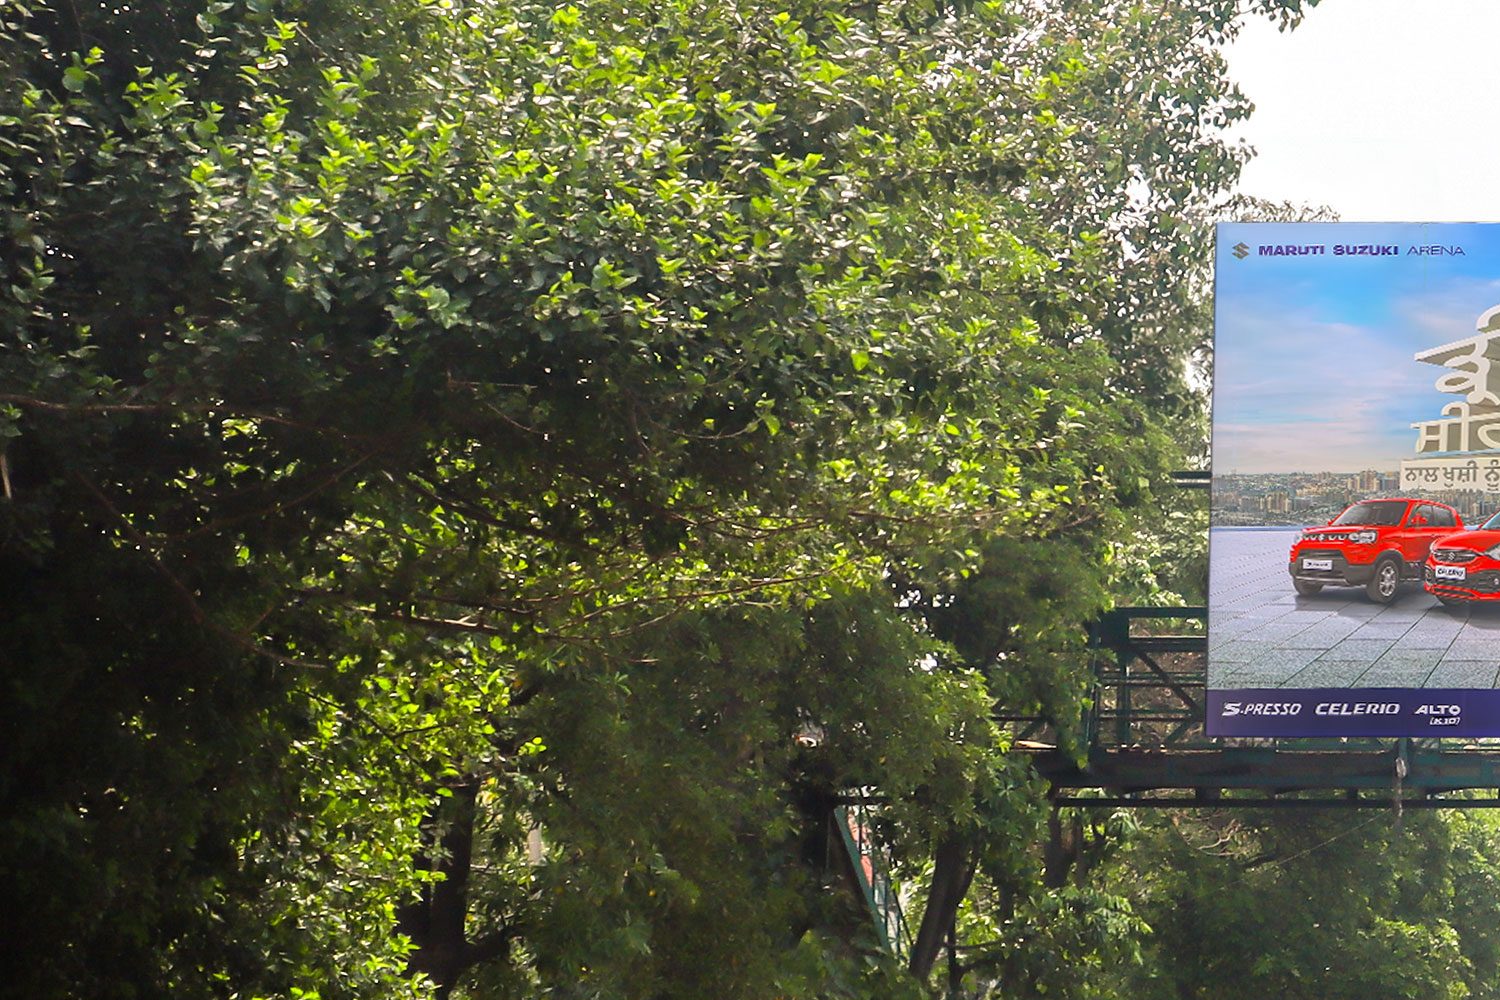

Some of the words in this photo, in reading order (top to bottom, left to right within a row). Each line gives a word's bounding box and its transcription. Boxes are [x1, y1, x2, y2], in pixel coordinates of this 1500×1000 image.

[1258, 244, 1325, 256] MARUTI
[1333, 244, 1399, 256] SUZUKI
[1406, 244, 1467, 256] ARENA
[1404, 466, 1440, 483] ਨਾਲ
[1315, 703, 1400, 715] CELERIO
[1415, 704, 1461, 716] ALTO
